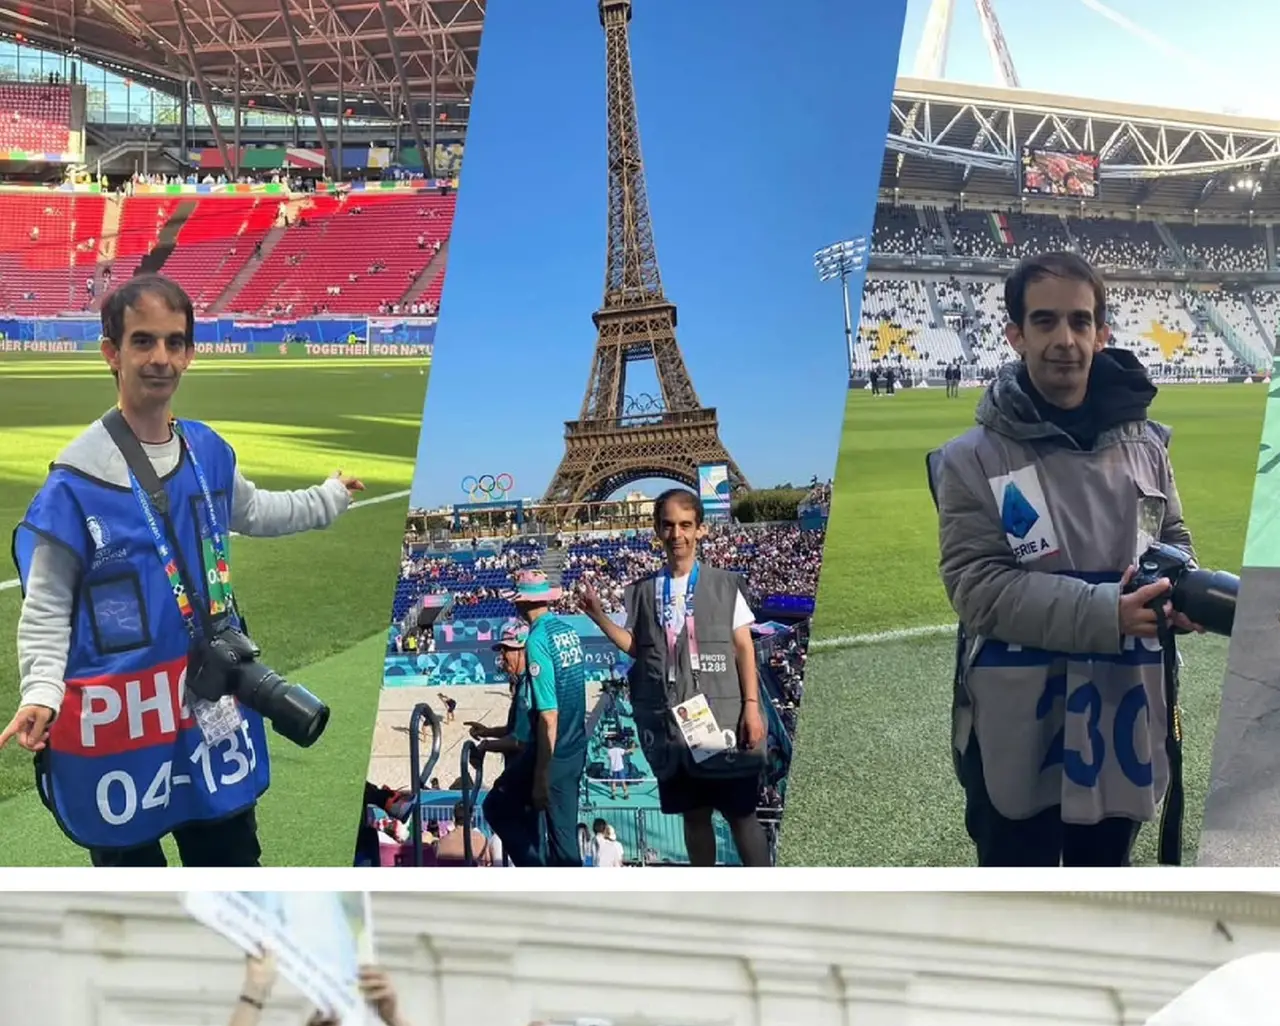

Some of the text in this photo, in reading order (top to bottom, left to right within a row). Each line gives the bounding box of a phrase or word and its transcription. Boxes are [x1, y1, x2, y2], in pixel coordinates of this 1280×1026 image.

[194, 343, 213, 354] OR
[305, 343, 369, 355] TOGETHER
[373, 344, 398, 355] FOR
[1013, 537, 1050, 558] ERIE A
[700, 654, 727, 662] PHOTO
[701, 662, 727, 672] 1288
[96, 719, 257, 825] 04-135
